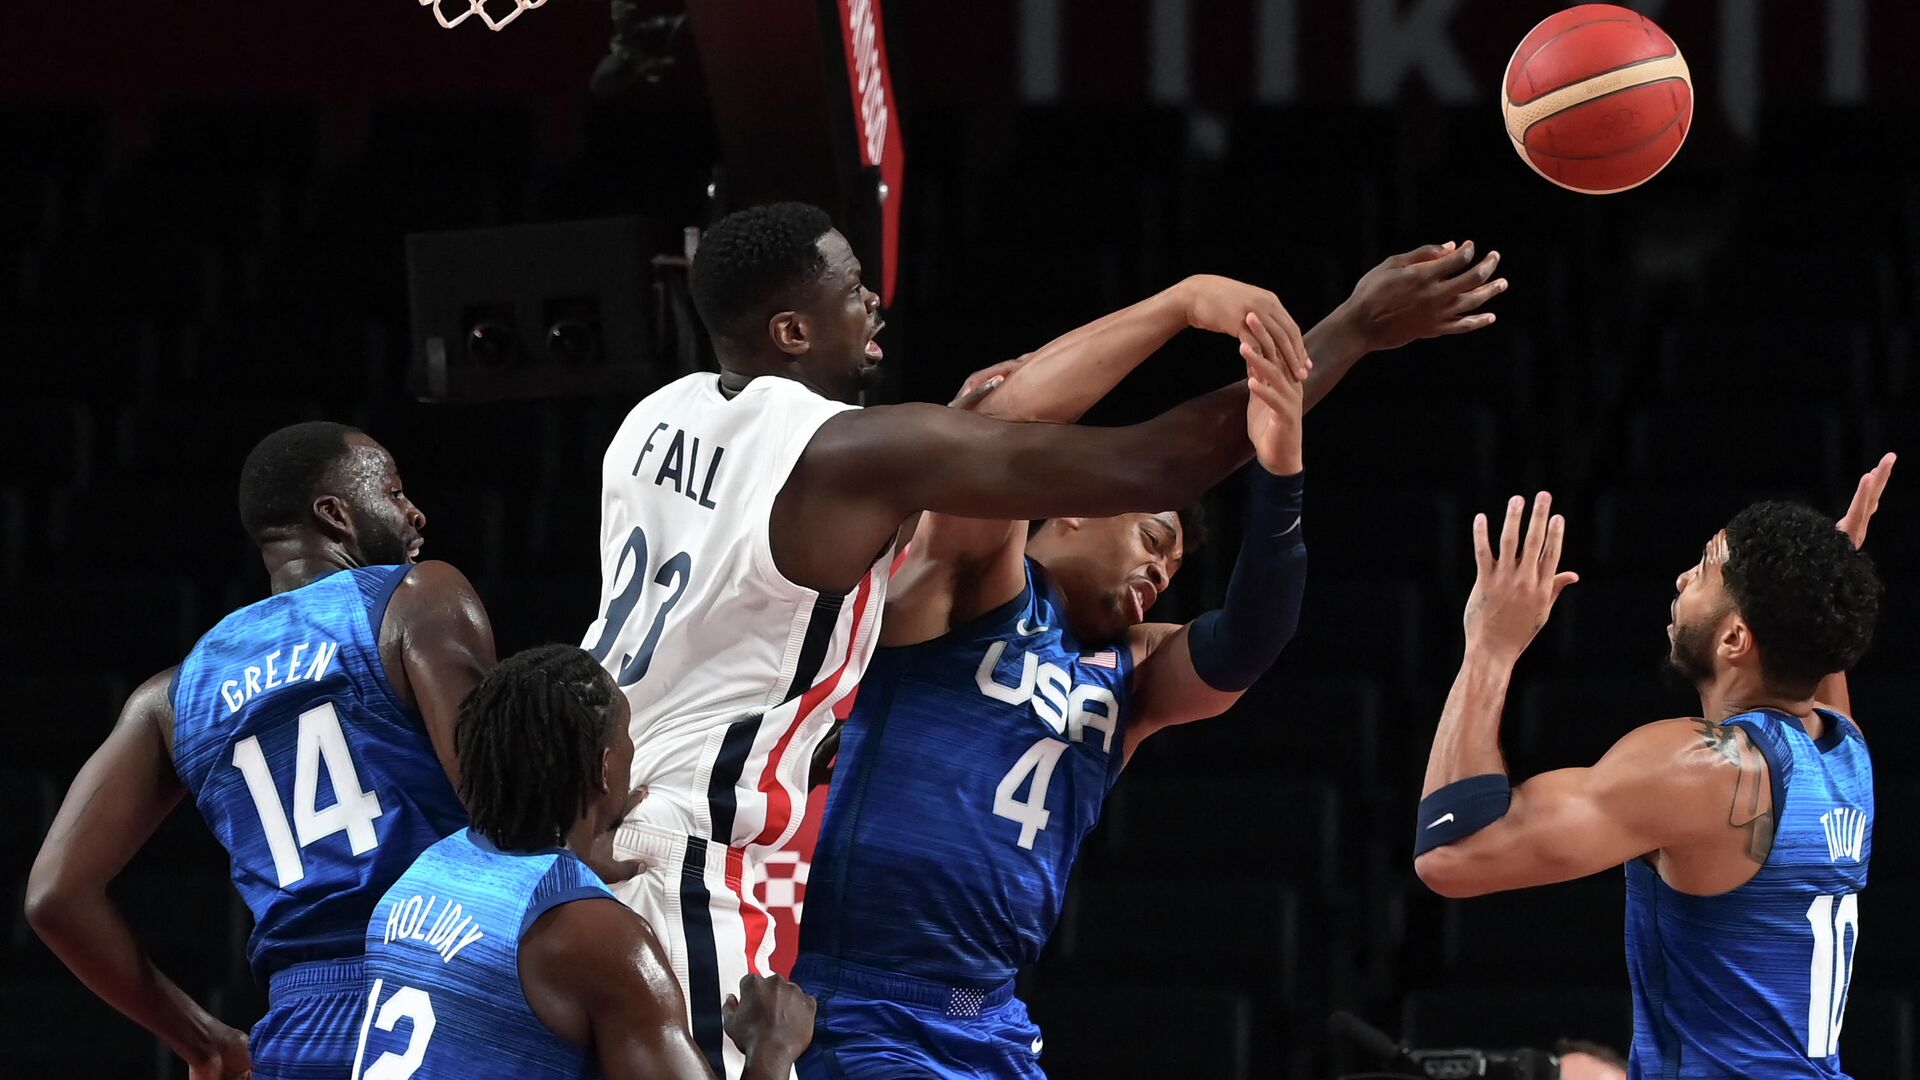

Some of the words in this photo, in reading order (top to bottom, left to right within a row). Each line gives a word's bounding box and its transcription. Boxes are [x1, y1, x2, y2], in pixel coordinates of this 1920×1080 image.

[632, 422, 725, 509] FALL
[221, 642, 337, 713] GREEN
[975, 640, 1119, 753] USA
[232, 701, 382, 888] 14
[992, 737, 1070, 850] 4
[1820, 808, 1867, 863] TATUM
[384, 895, 484, 963] HOLIDAY
[1806, 893, 1858, 1057] 10
[351, 978, 437, 1080] 12
